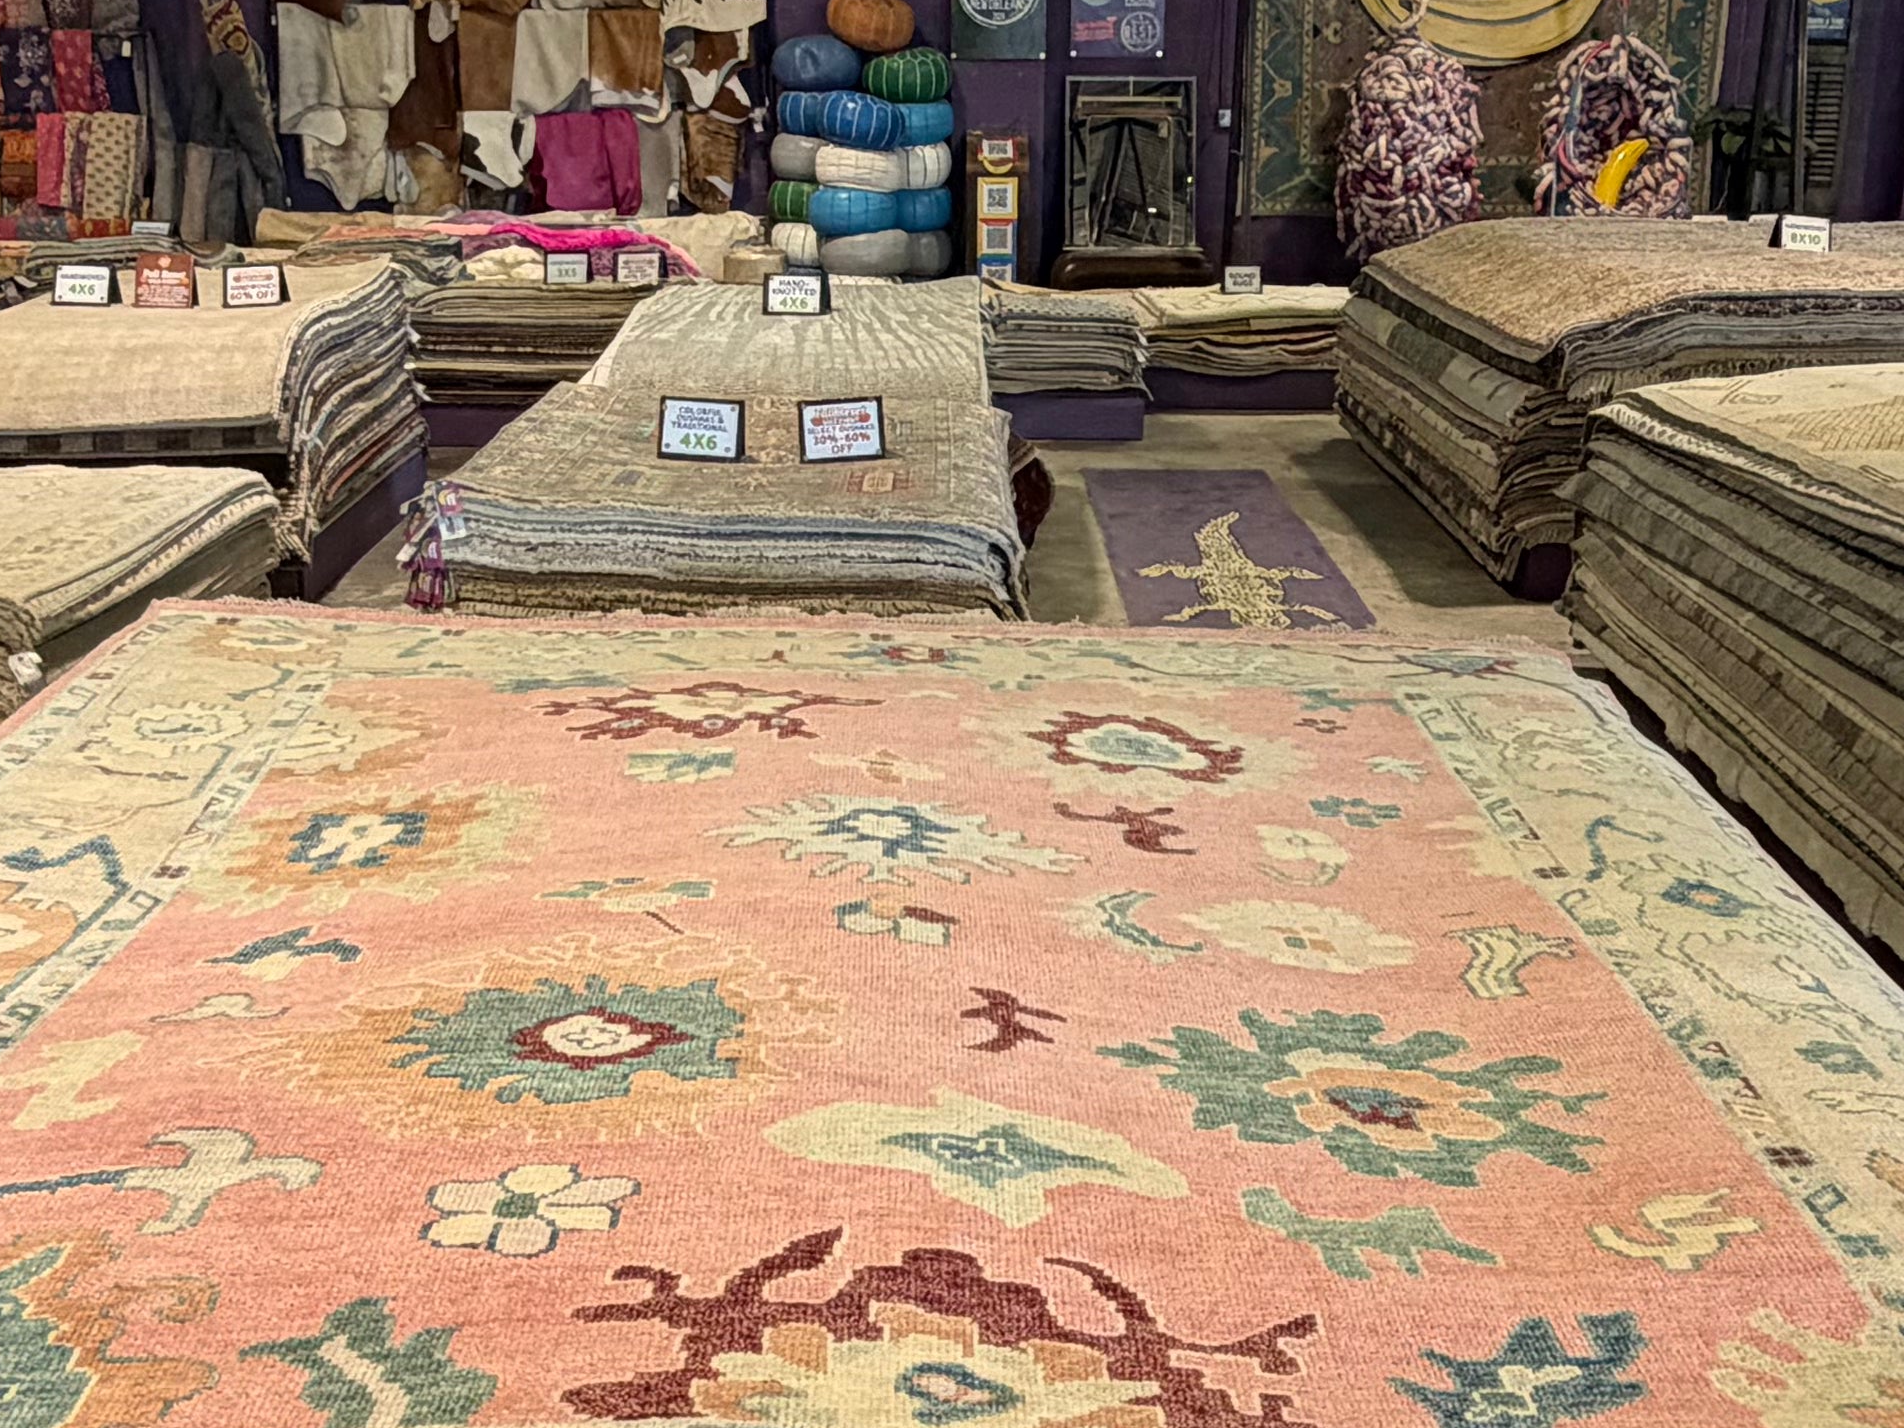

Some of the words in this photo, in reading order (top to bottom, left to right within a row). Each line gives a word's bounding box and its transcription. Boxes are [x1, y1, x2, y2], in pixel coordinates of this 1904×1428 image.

[1791, 232, 1821, 245] 8X10
[68, 283, 96, 295] 4X6
[779, 296, 809, 309] 4X6
[679, 432, 718, 450] 4X6
[831, 443, 853, 454] OFF
